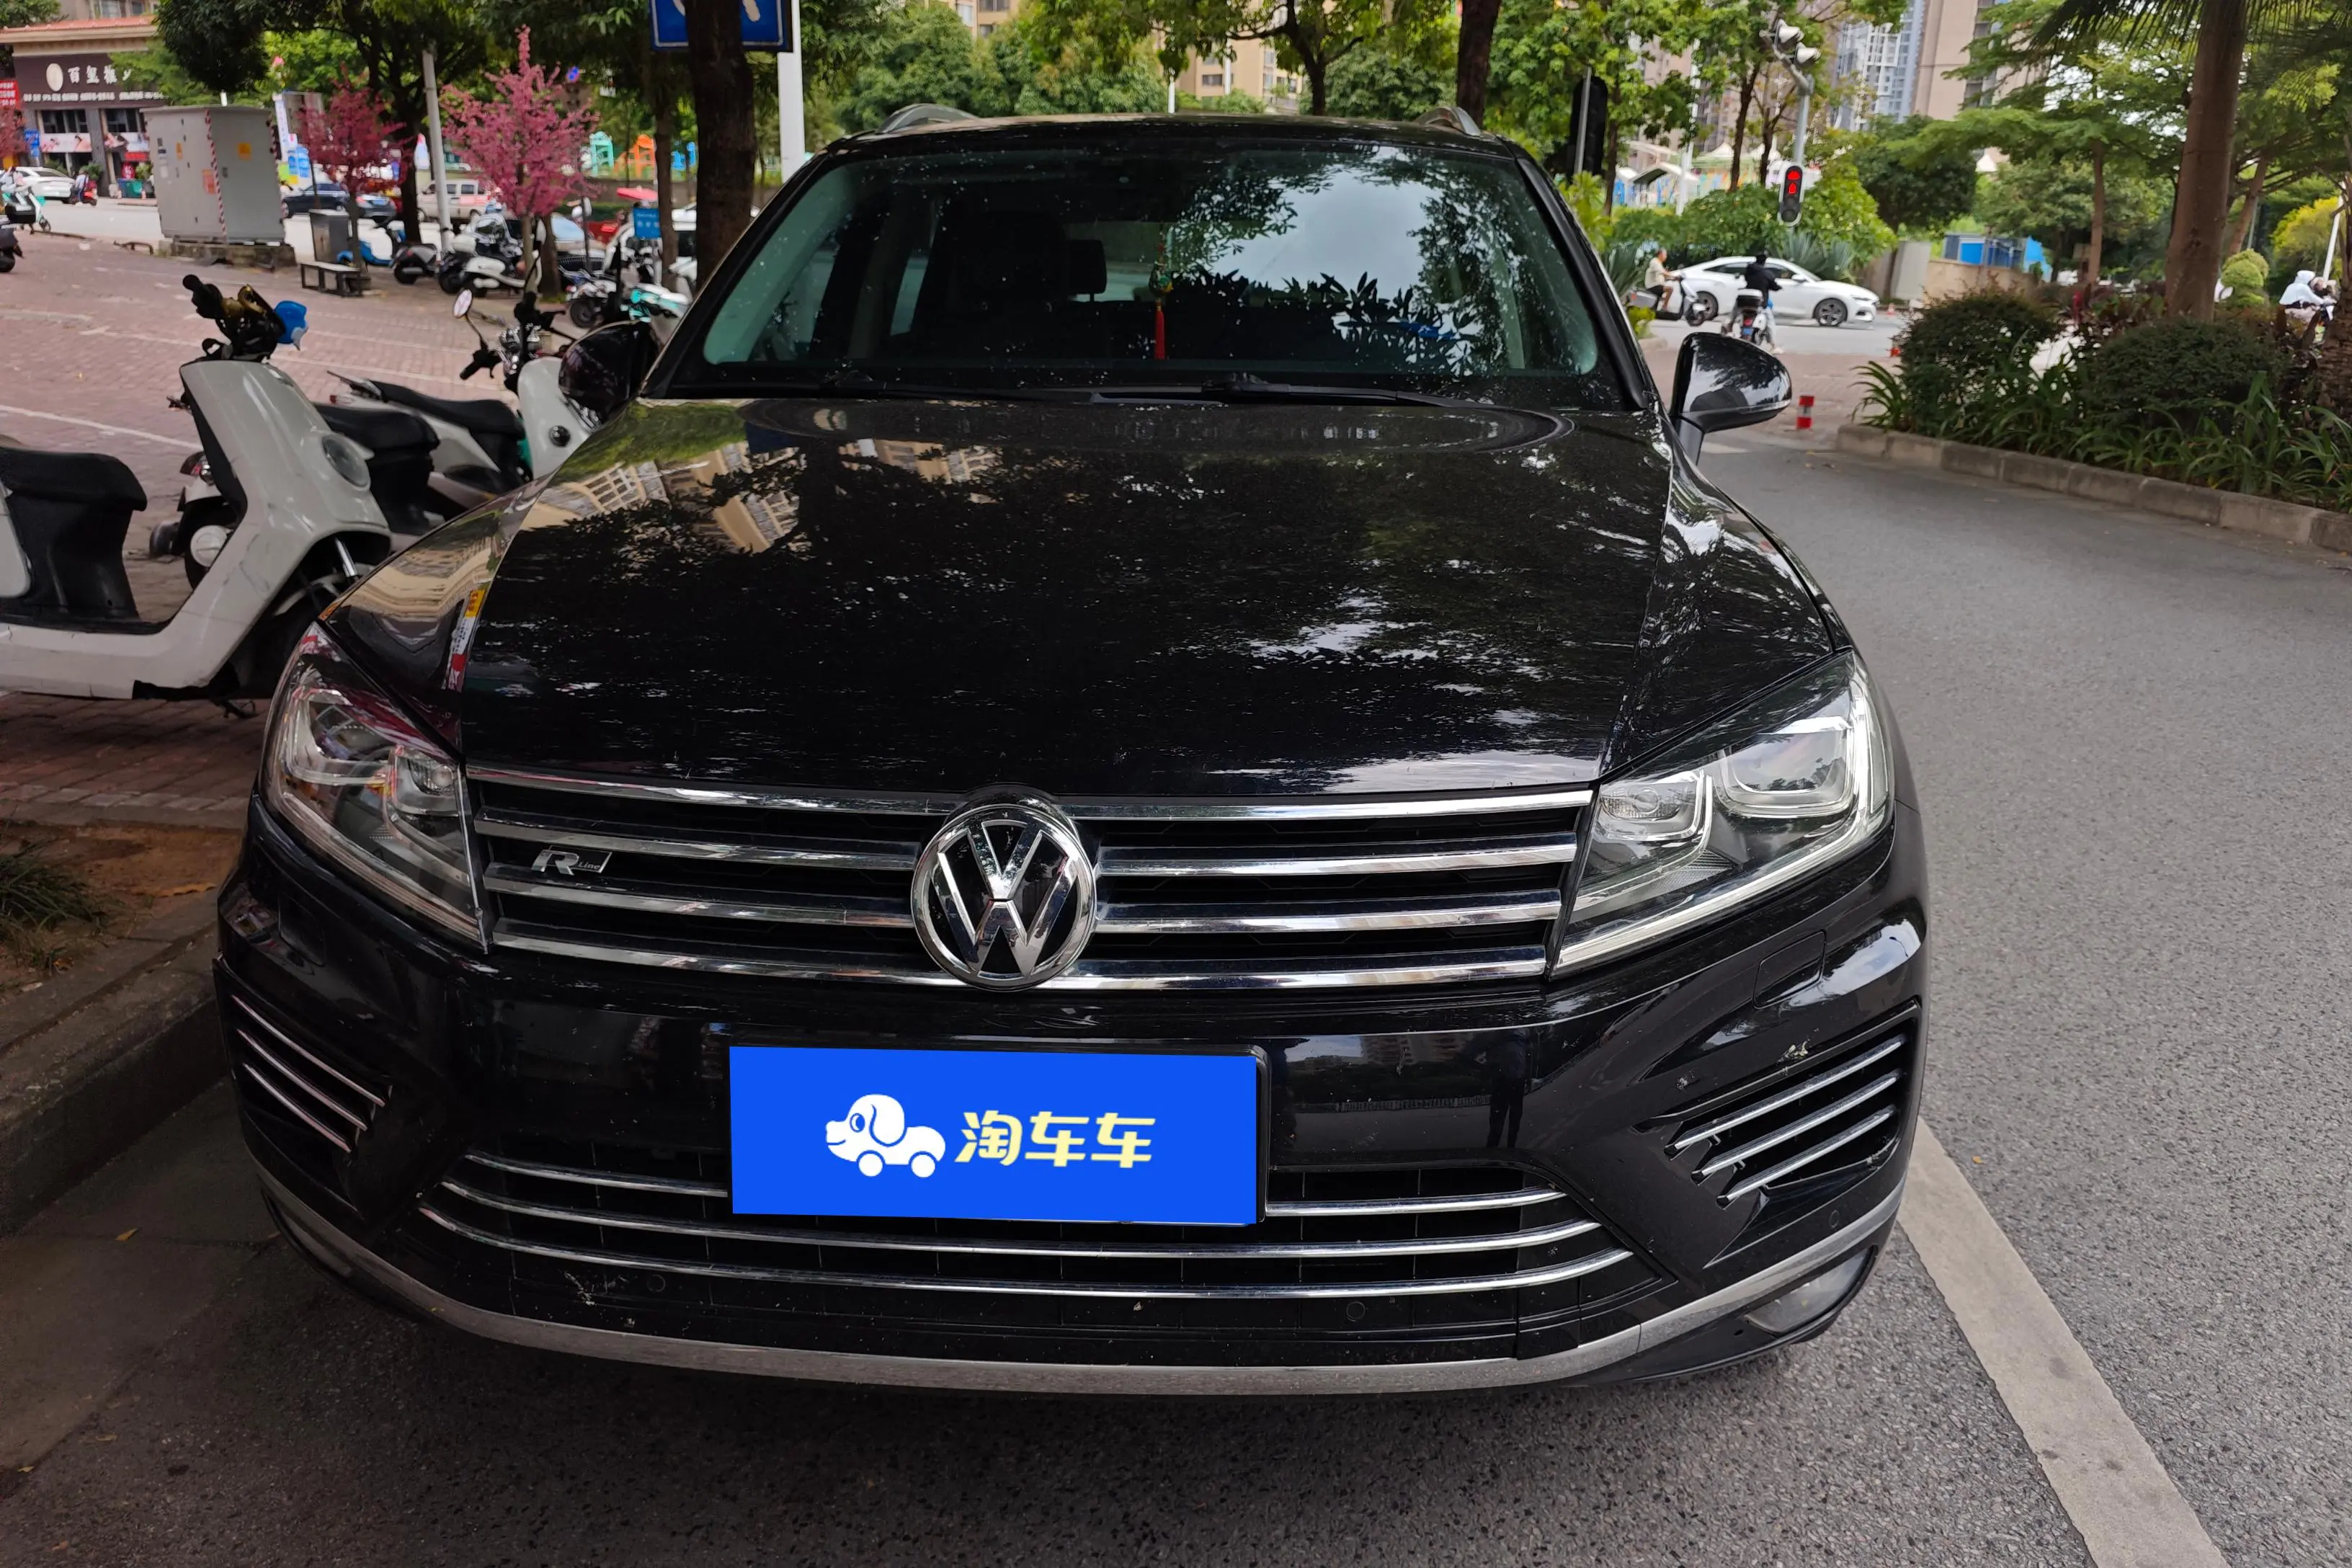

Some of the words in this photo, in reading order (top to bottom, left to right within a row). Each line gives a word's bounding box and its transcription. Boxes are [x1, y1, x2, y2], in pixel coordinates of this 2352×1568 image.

[531, 850, 579, 876] R
[578, 861, 600, 870] Line
[925, 813, 1082, 983] VW
